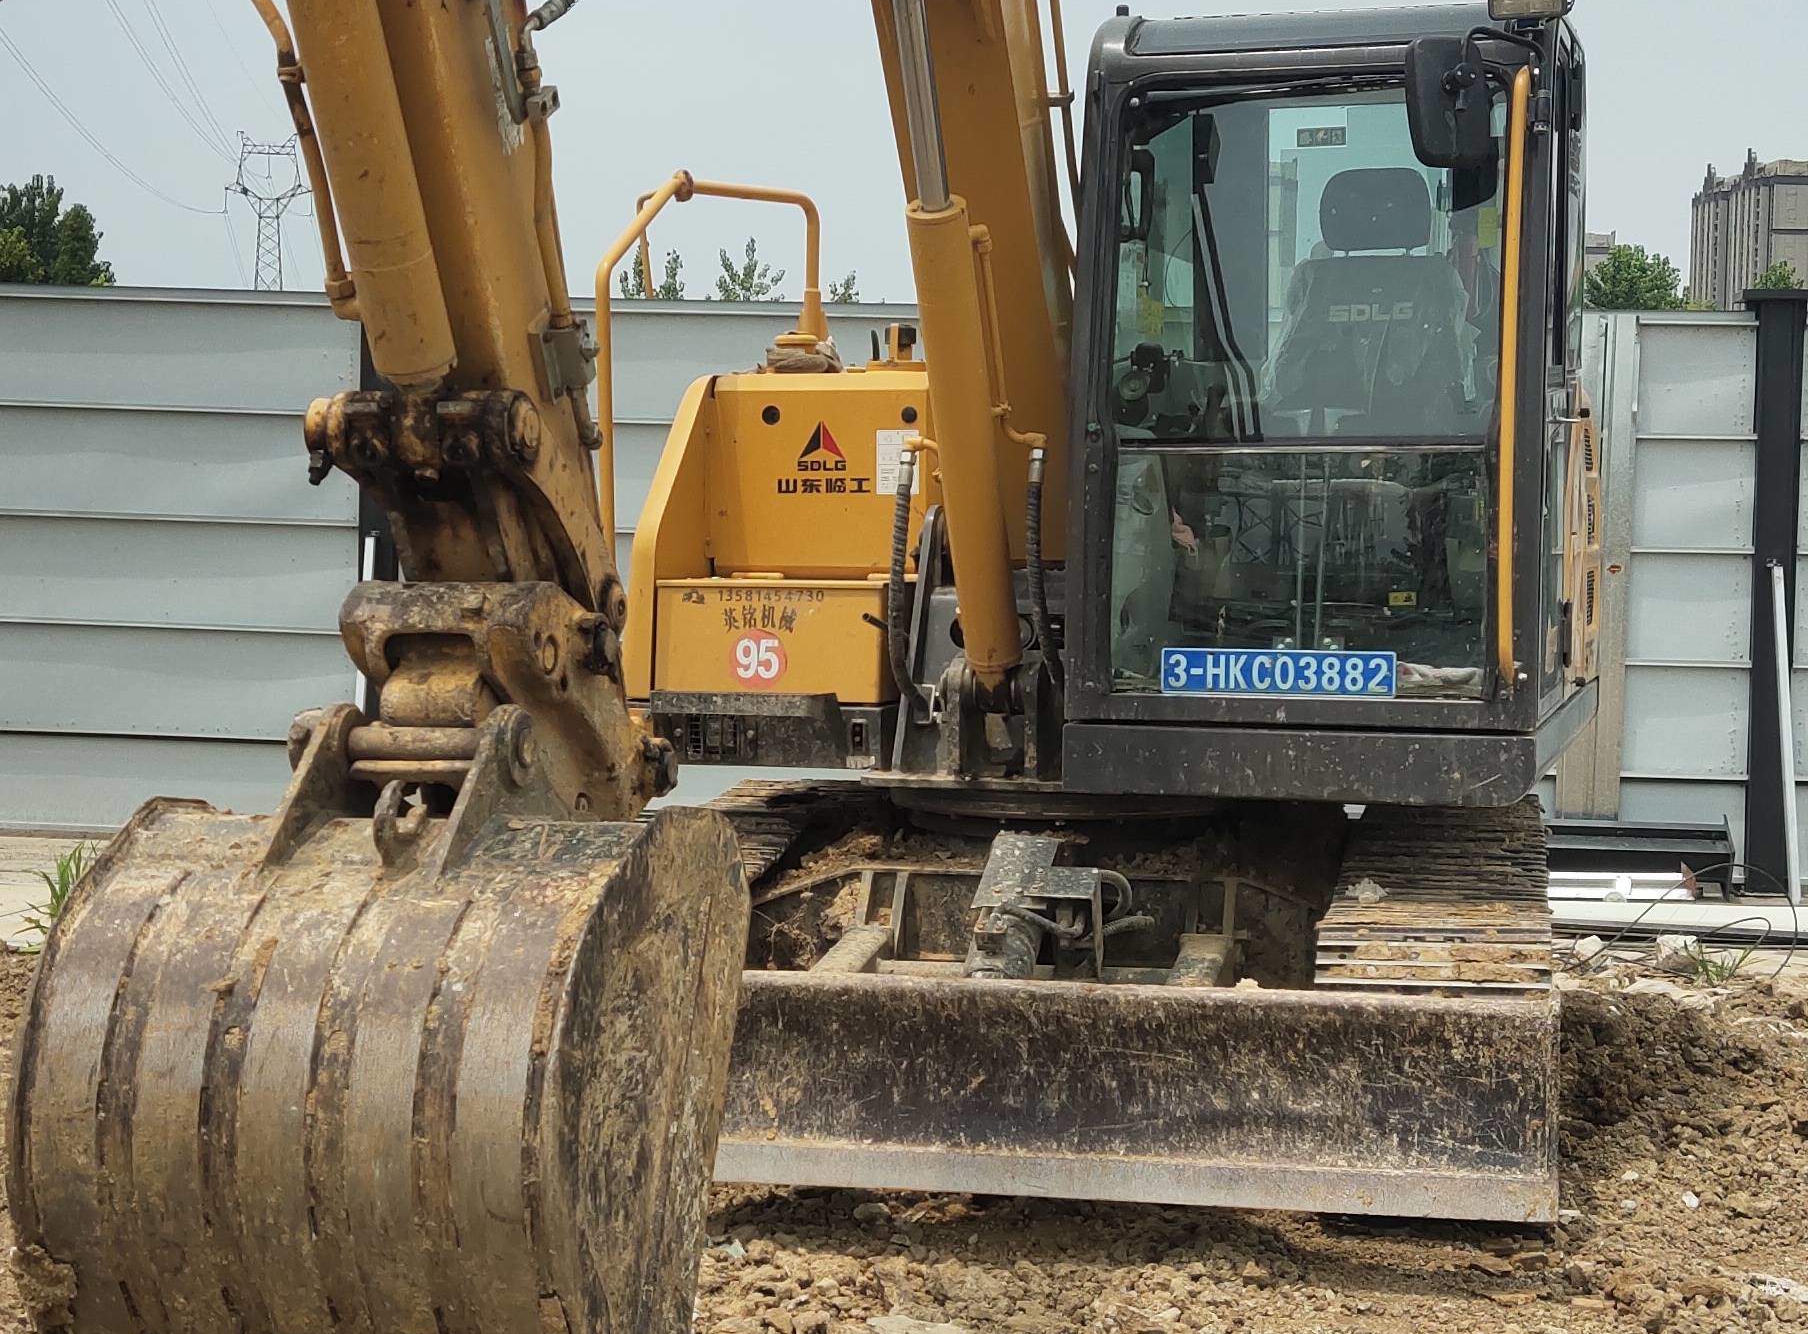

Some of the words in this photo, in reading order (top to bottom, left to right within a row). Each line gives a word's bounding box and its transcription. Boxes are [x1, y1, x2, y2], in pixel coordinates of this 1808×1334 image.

[1328, 301, 1414, 322] SDLG
[797, 460, 847, 472] SDLG
[777, 477, 871, 494] 山东临工
[735, 638, 780, 679] 95
[1168, 653, 1389, 693] 3-HKC03882
